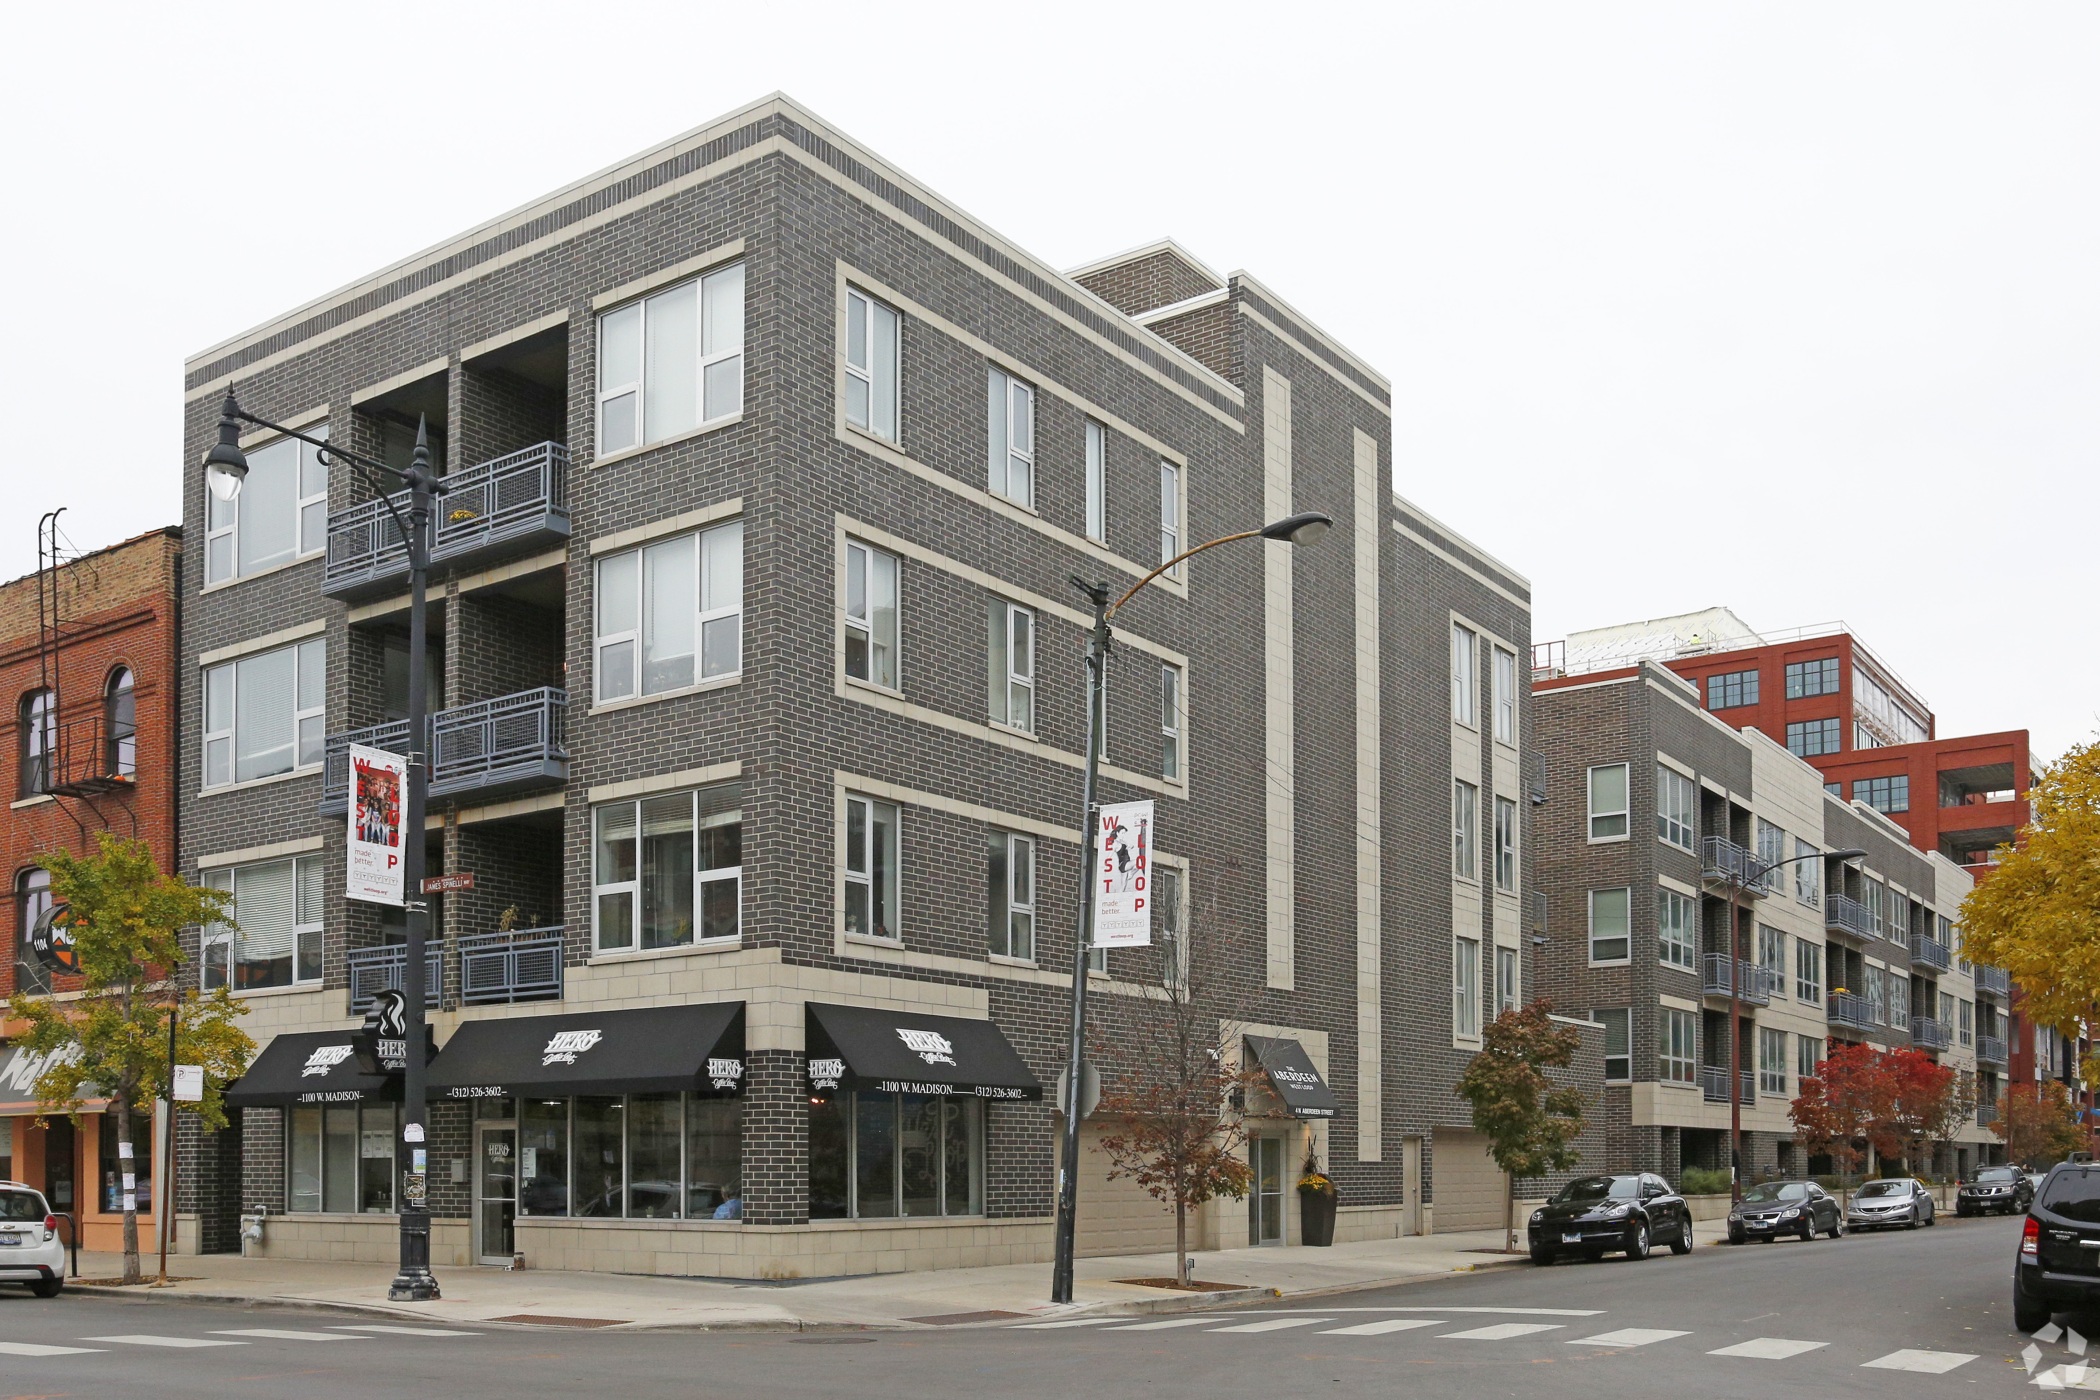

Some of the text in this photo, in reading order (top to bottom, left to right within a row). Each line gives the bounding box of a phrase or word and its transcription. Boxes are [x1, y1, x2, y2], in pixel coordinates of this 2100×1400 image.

[353, 756, 370, 840] WEST
[387, 786, 400, 869] LOOP
[355, 849, 372, 857] made
[1103, 815, 1119, 893] WEST
[1135, 834, 1146, 912] LOOP
[426, 882, 441, 891] JAMES
[442, 880, 463, 888] SPINELLI
[376, 1039, 406, 1058] HER
[544, 1030, 602, 1053] HERO
[895, 1029, 953, 1054] HERO
[305, 1045, 354, 1066] HERO
[707, 1058, 744, 1078] HERO
[808, 1059, 846, 1078] HERO
[1273, 1070, 1319, 1083] ABERDEEN
[900, 1082, 910, 1092] W.
[488, 1144, 510, 1157] HERO
